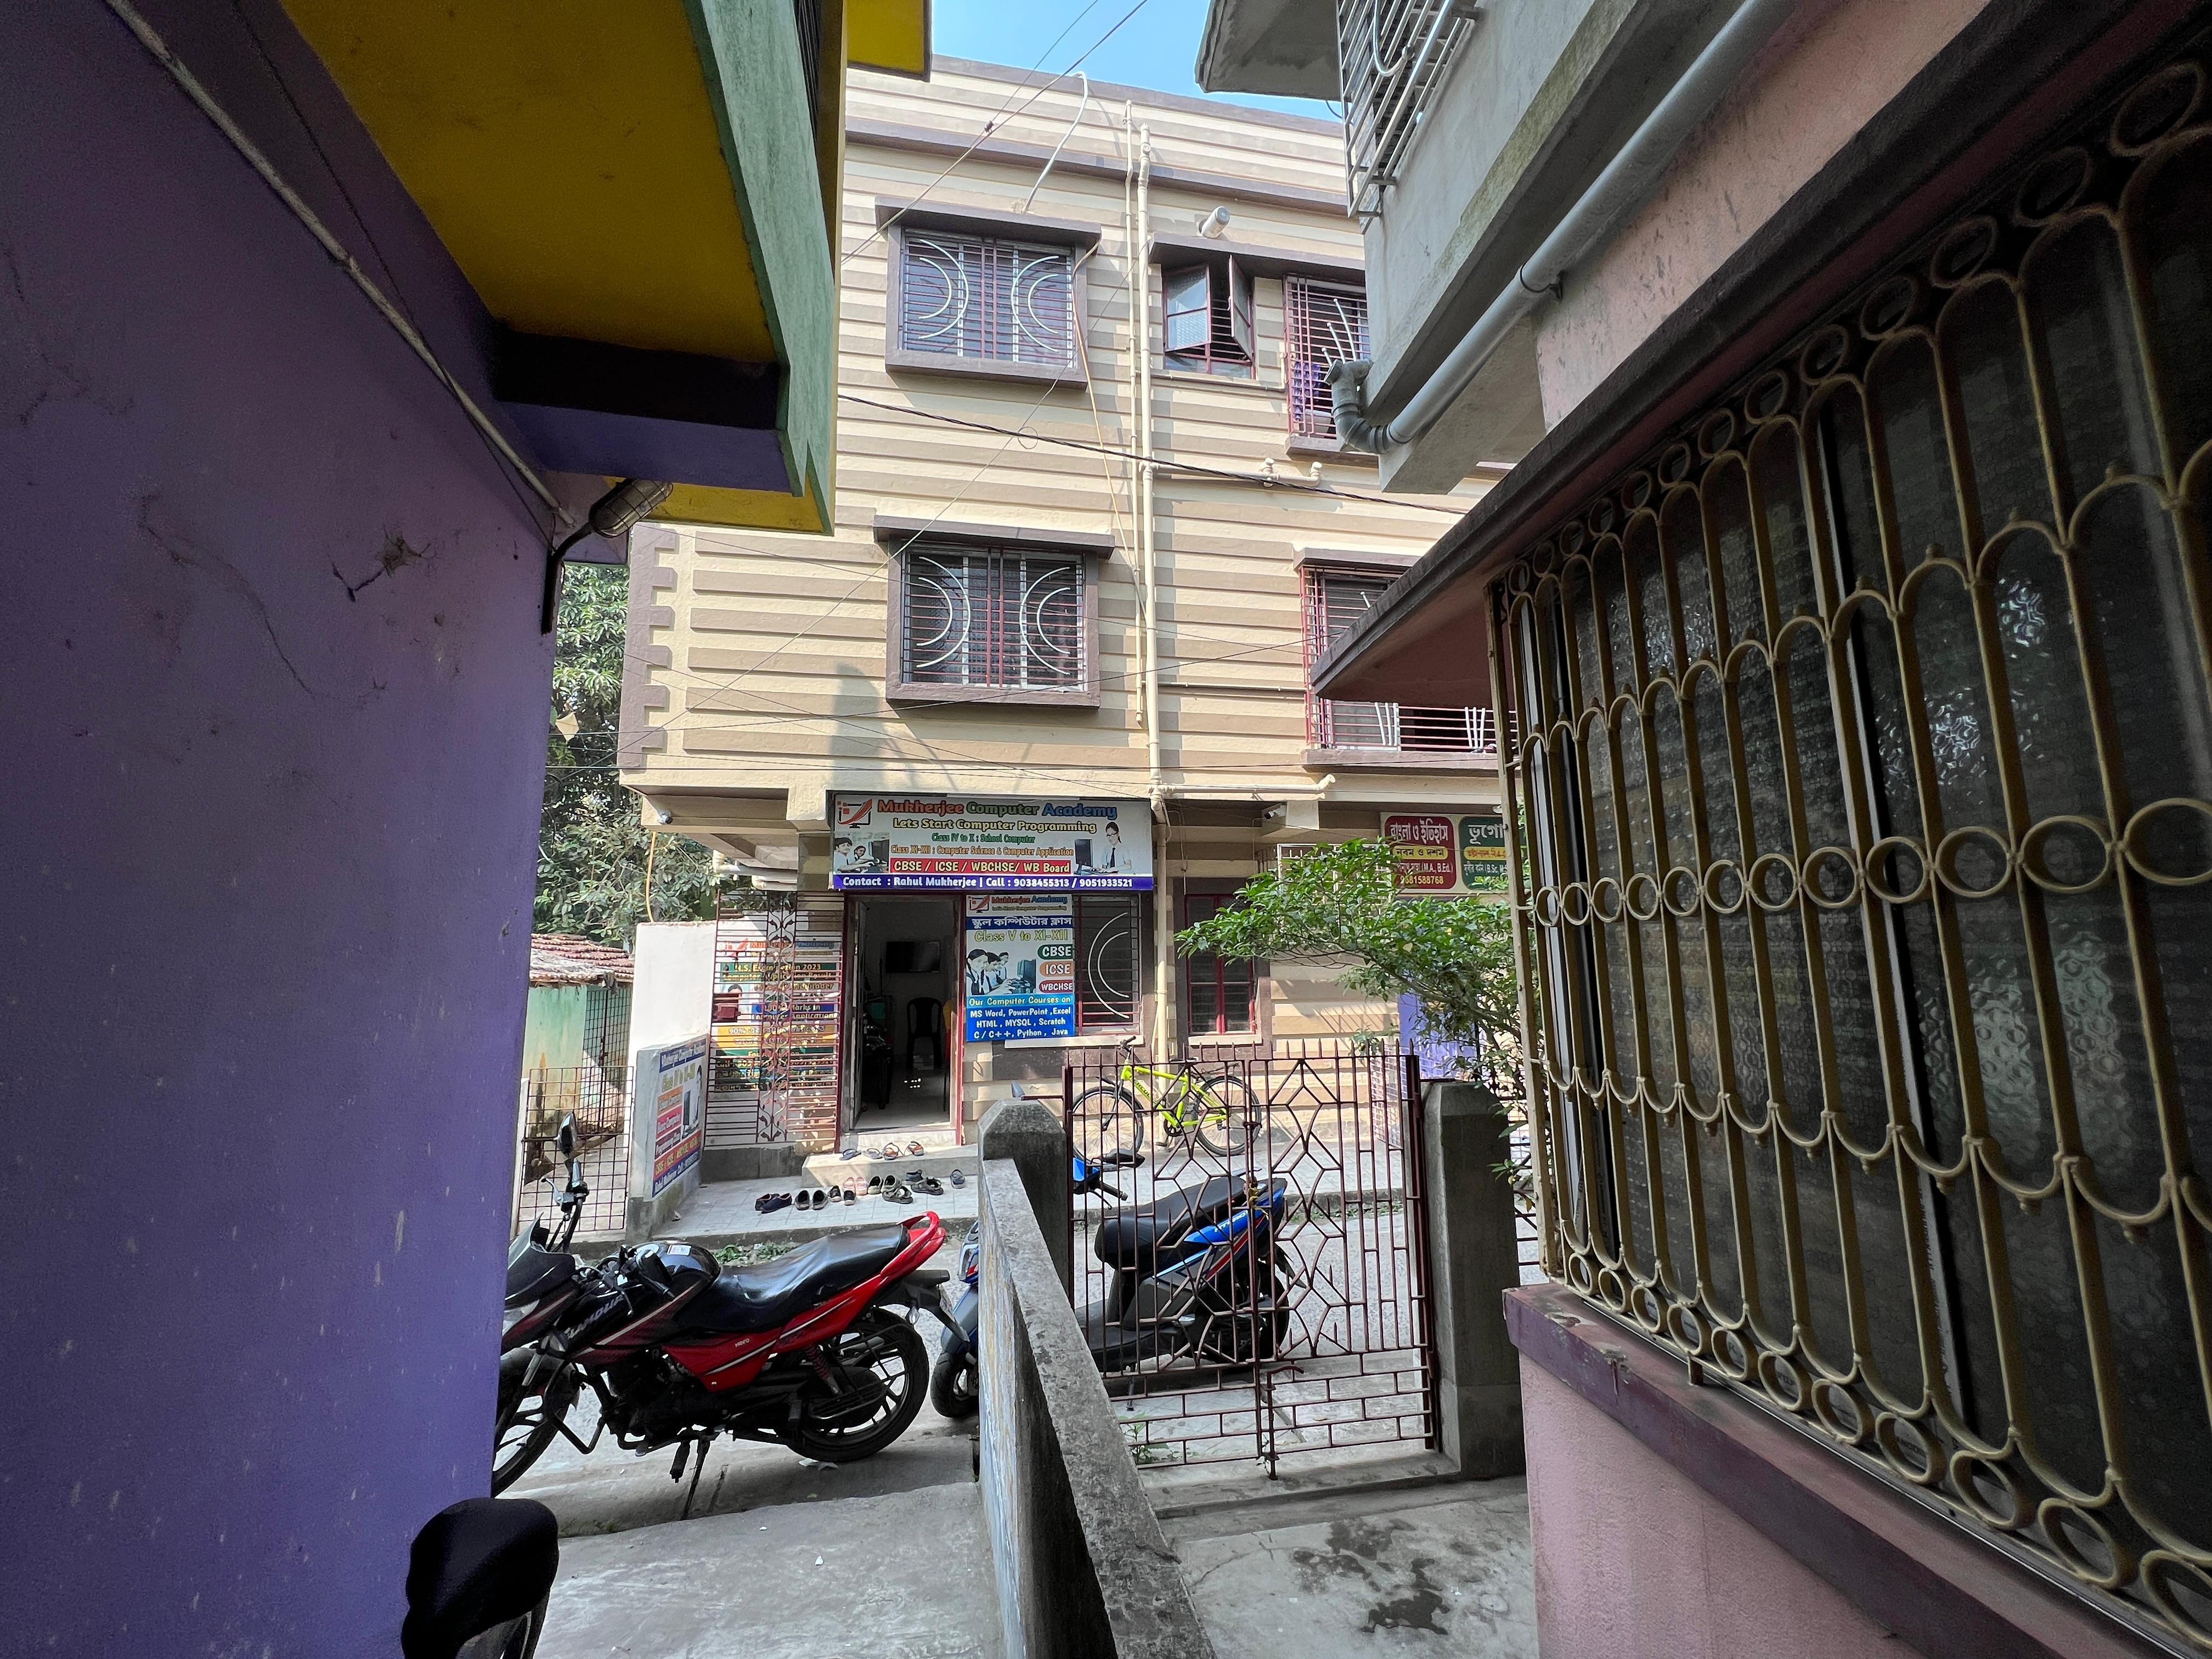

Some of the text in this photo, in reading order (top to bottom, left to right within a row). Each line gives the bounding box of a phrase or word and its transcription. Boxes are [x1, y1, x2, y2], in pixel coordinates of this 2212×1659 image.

[878, 799, 1118, 820] Mukherjee Computer Academy
[893, 818, 1097, 833] Lets Start Computer Programming
[1390, 818, 1448, 844] বাংলা ও ইতিহাস
[932, 833, 950, 842] Class
[951, 833, 960, 842] IV
[961, 833, 968, 842] to
[969, 834, 975, 842] X
[980, 834, 1002, 843] School
[1004, 834, 1036, 845] Computer
[1468, 823, 1504, 845] ভূগো
[891, 845, 909, 854] Class
[910, 845, 930, 854] XI-XII
[937, 845, 969, 856] Computer
[970, 847, 994, 855] Science
[1003, 847, 1034, 857] Computer
[1036, 847, 1074, 857] Application
[894, 861, 922, 871] CBSE
[924, 861, 931, 872] /
[935, 861, 958, 871] ICSE
[961, 862, 968, 872] /
[1023, 862, 1040, 872] WB
[1043, 862, 1069, 872] Board
[843, 877, 881, 885] Contact
[894, 877, 923, 886] Rahul
[926, 877, 976, 888] Mukherjee
[986, 878, 1005, 887] Call
[1013, 879, 1069, 887] 9038455313
[1071, 878, 1077, 888] /
[1079, 879, 1132, 887] 9051933521
[991, 895, 1068, 905] Mukherjee Academy
[972, 915, 1073, 929] স্কুল কম্পিউটার ক্লাস
[974, 929, 1068, 942] Class V to XI-XII
[1042, 946, 1072, 957] CBSE
[1045, 964, 1071, 975] ICSE
[987, 997, 1025, 1007] Computer
[1028, 996, 1059, 1005] Courses
[985, 1009, 1006, 1018] Word,
[977, 1020, 997, 1028] HTML
[1039, 1017, 1066, 1025] Scratch
[1017, 1029, 1042, 1038] Python
